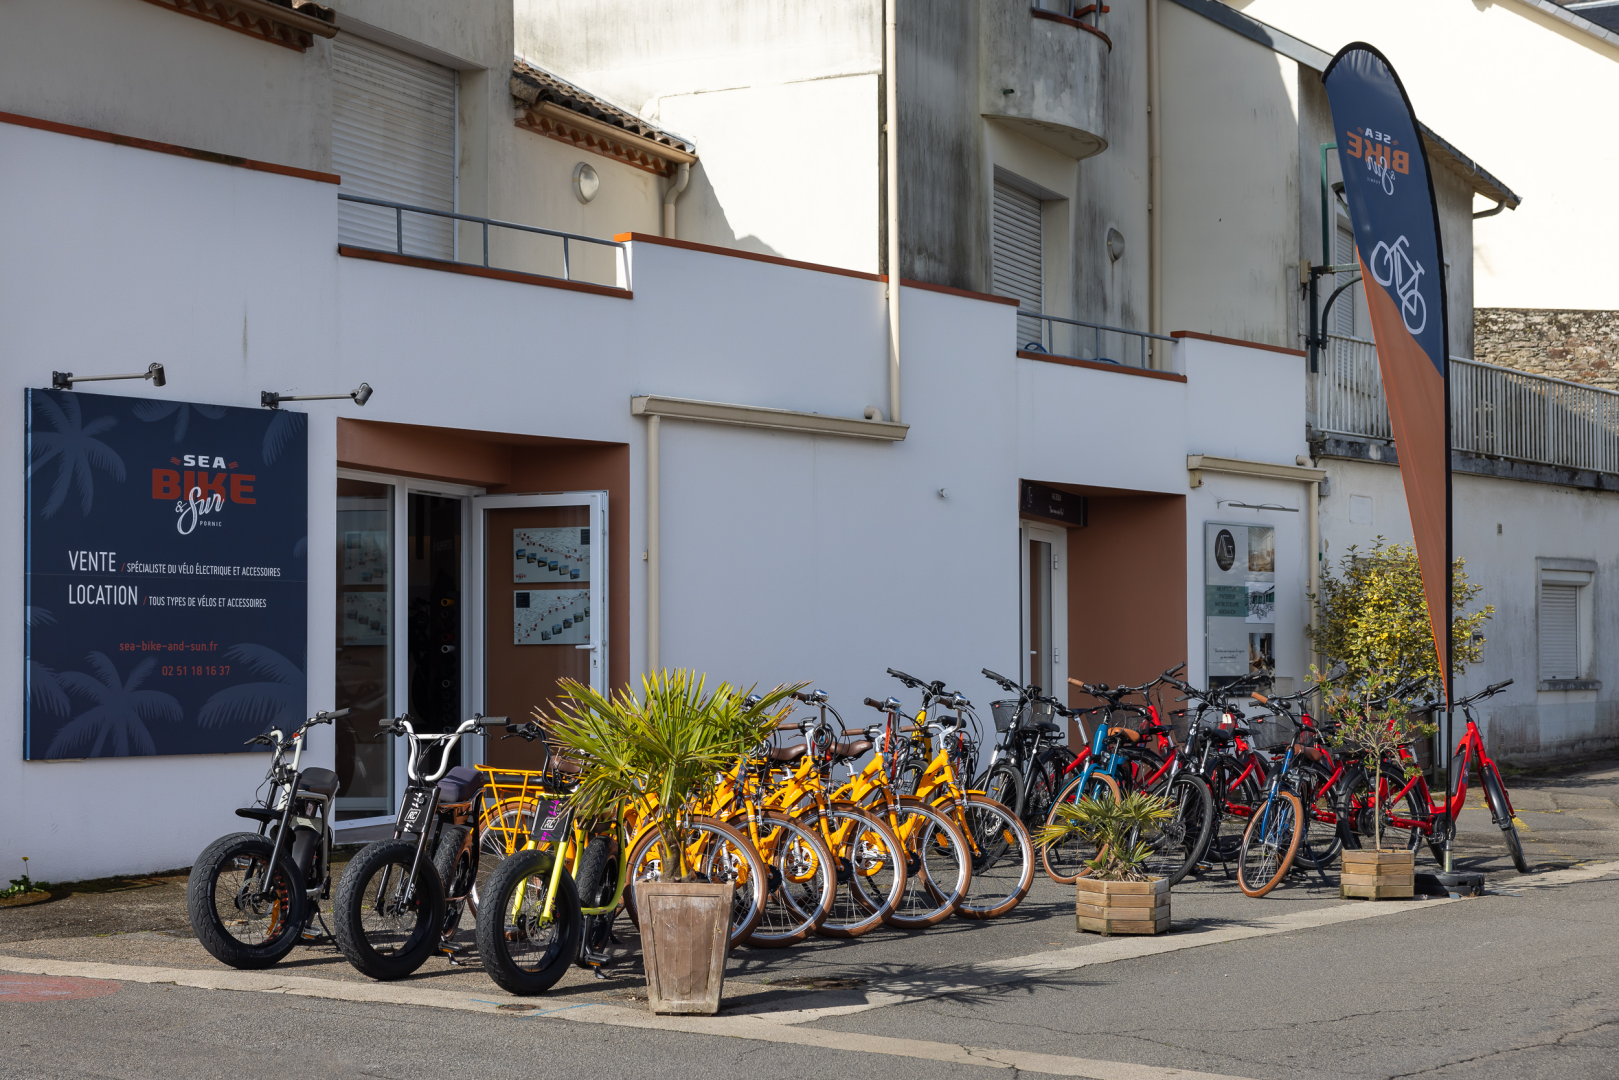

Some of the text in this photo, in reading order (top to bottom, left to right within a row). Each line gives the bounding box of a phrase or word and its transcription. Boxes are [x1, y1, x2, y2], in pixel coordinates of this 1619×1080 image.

[183, 454, 226, 469] SEA
[152, 468, 256, 505] BIKE
[175, 486, 225, 535] & Sun
[68, 550, 117, 572] VENTE
[127, 561, 166, 574] SPÉCIALISTE
[167, 564, 177, 574] DU
[178, 562, 194, 575] VÉLO
[195, 563, 232, 576] ÉLECTRIQUE
[232, 566, 241, 576] ET
[241, 567, 281, 577] ACCESSOIRES
[68, 584, 138, 606] LOCATION
[148, 596, 166, 606] TOUS
[167, 596, 187, 607] TYPES
[187, 597, 196, 607] DE
[197, 595, 217, 607] VÉLOS
[218, 597, 226, 607] ET
[227, 598, 267, 608] ACCESSOIRES
[119, 640, 218, 652] sea-bike-and-sun.fr
[161, 665, 231, 676] 02 51 18 16 37
